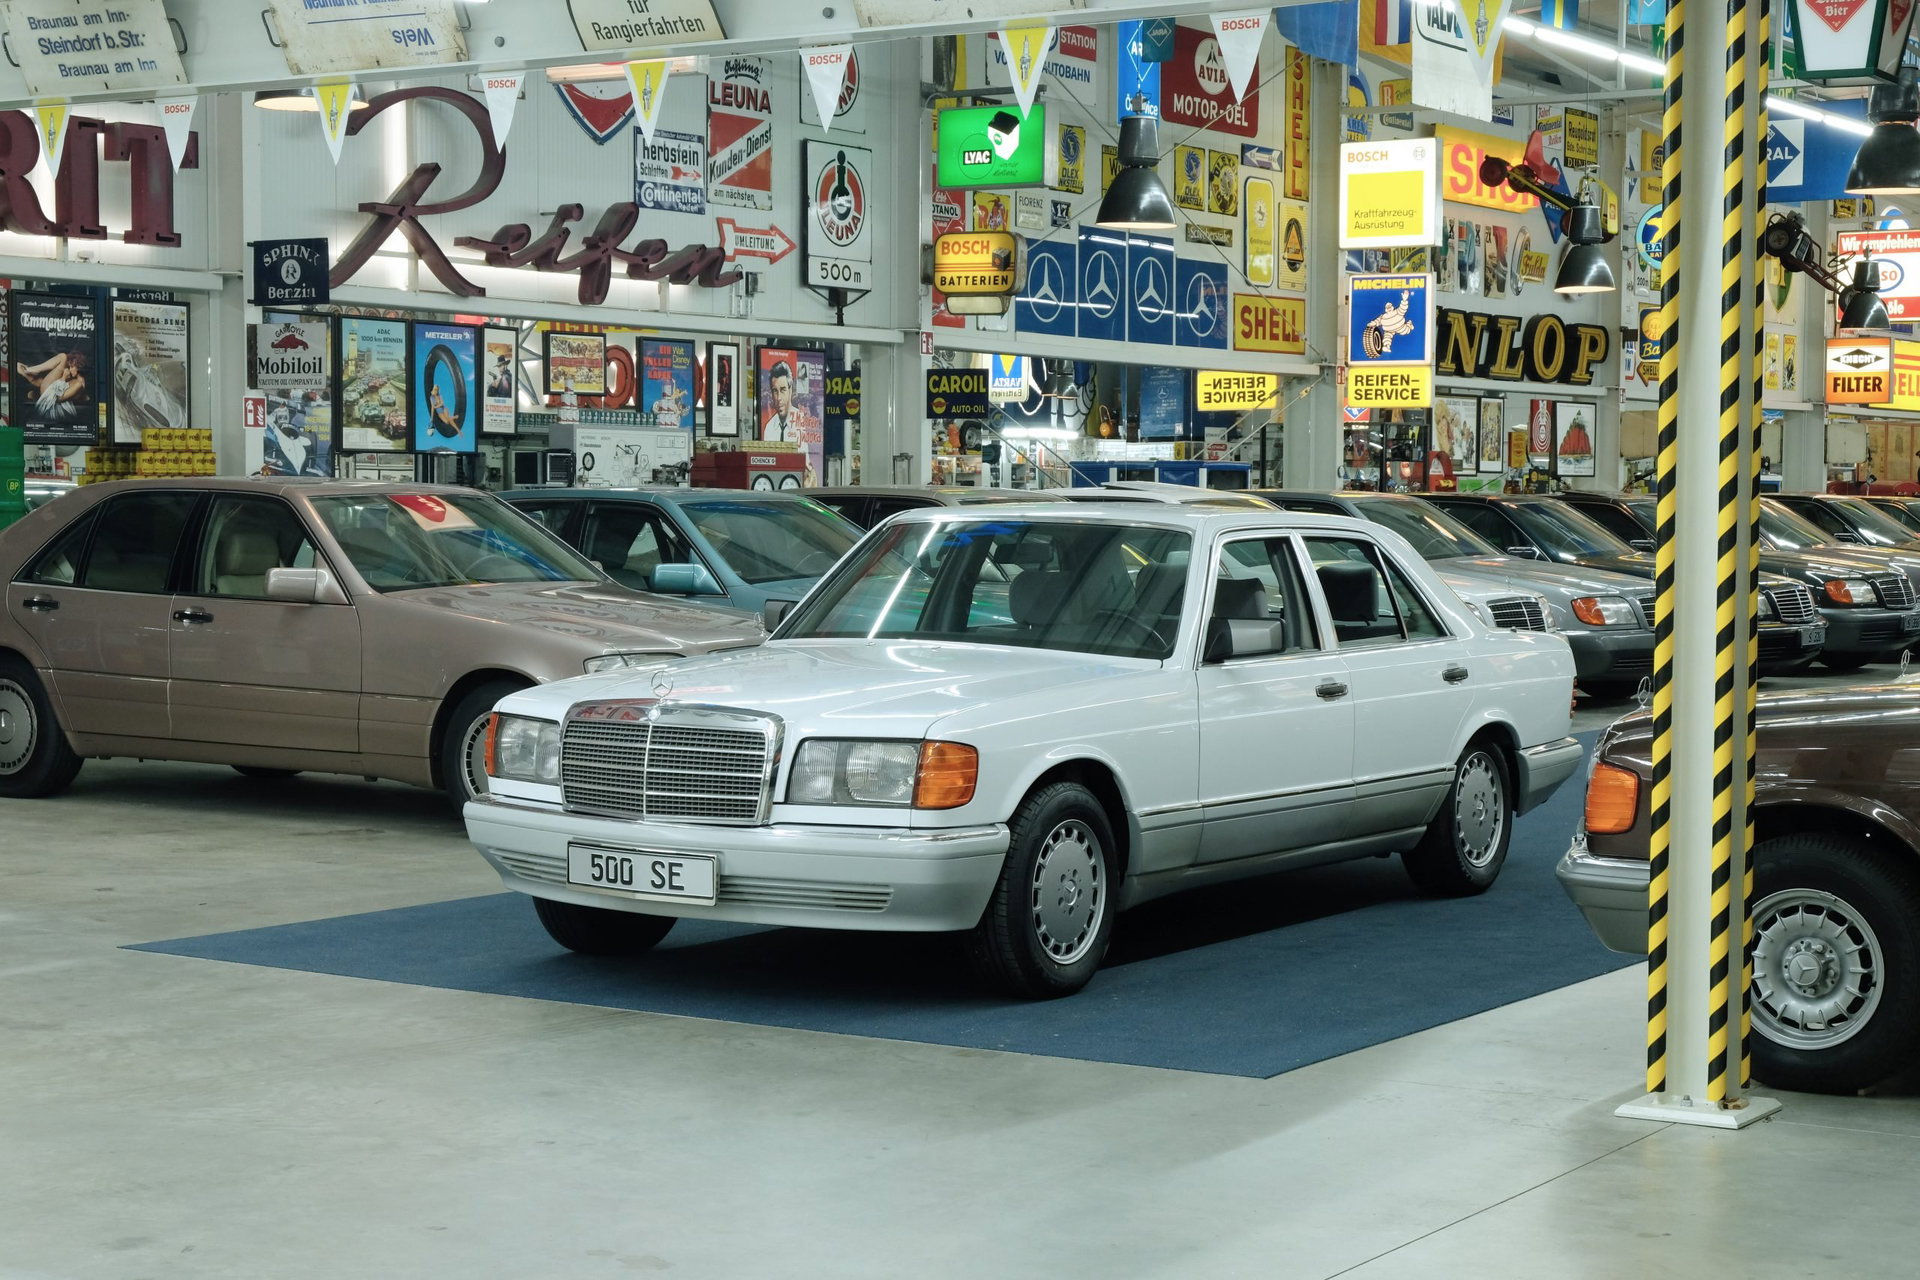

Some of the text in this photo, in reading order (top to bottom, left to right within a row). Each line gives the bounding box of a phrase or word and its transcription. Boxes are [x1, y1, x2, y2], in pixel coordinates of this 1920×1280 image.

[1824, 5, 1849, 17] Bier
[27, 16, 79, 31] Braunau
[83, 14, 103, 26] am
[591, 17, 706, 42] Rangierfahrten
[1221, 18, 1260, 31] BOSCH
[38, 33, 102, 55] Steindorf
[391, 28, 435, 47] Wels
[1060, 31, 1096, 50] STATION
[58, 58, 158, 78] Braunau am Inn
[809, 53, 842, 66] BOSCH
[1041, 61, 1091, 84] AUTOBAHN
[1198, 64, 1228, 84] AVIA
[487, 79, 517, 89] BOSCH
[710, 80, 772, 114] LEUNA
[164, 103, 191, 114] BOSCH
[1173, 93, 1249, 127] MOTOR-OEL
[1291, 51, 1304, 197] SHELL
[709, 122, 772, 183] Kunden-Dienst
[964, 151, 990, 164] LYAC
[1347, 150, 1389, 163] BOSCH
[1061, 167, 1079, 179] OLEX
[328, 86, 743, 305] Reifen
[641, 182, 700, 206] Continental
[714, 187, 755, 202] am nächsten
[1018, 195, 1043, 209] FLORENZ
[1354, 207, 1416, 220] Kraftfahrzeug-
[819, 207, 861, 241] LEUNA
[734, 233, 775, 250] UMLEITUNG
[941, 239, 990, 256] BOSCH
[1841, 236, 1861, 251] Wir
[1521, 254, 1546, 277] Fulda
[940, 275, 1009, 286] BATTERIEN
[1353, 278, 1425, 290] MICHELIN
[267, 283, 317, 299] Benzin
[274, 324, 305, 338] GARGOYLE
[1240, 304, 1300, 343] SHELL
[425, 331, 463, 341] METZELER
[258, 356, 323, 375] Mobiloil
[928, 374, 987, 394] CAROIL
[1354, 374, 1420, 386] REIFEN-
[1832, 376, 1883, 393] FILTER
[1354, 388, 1420, 400] SERVICE
[951, 404, 985, 414] AUTO-OIL
[9, 480, 19, 491] BP
[590, 853, 685, 891] 500 SE
